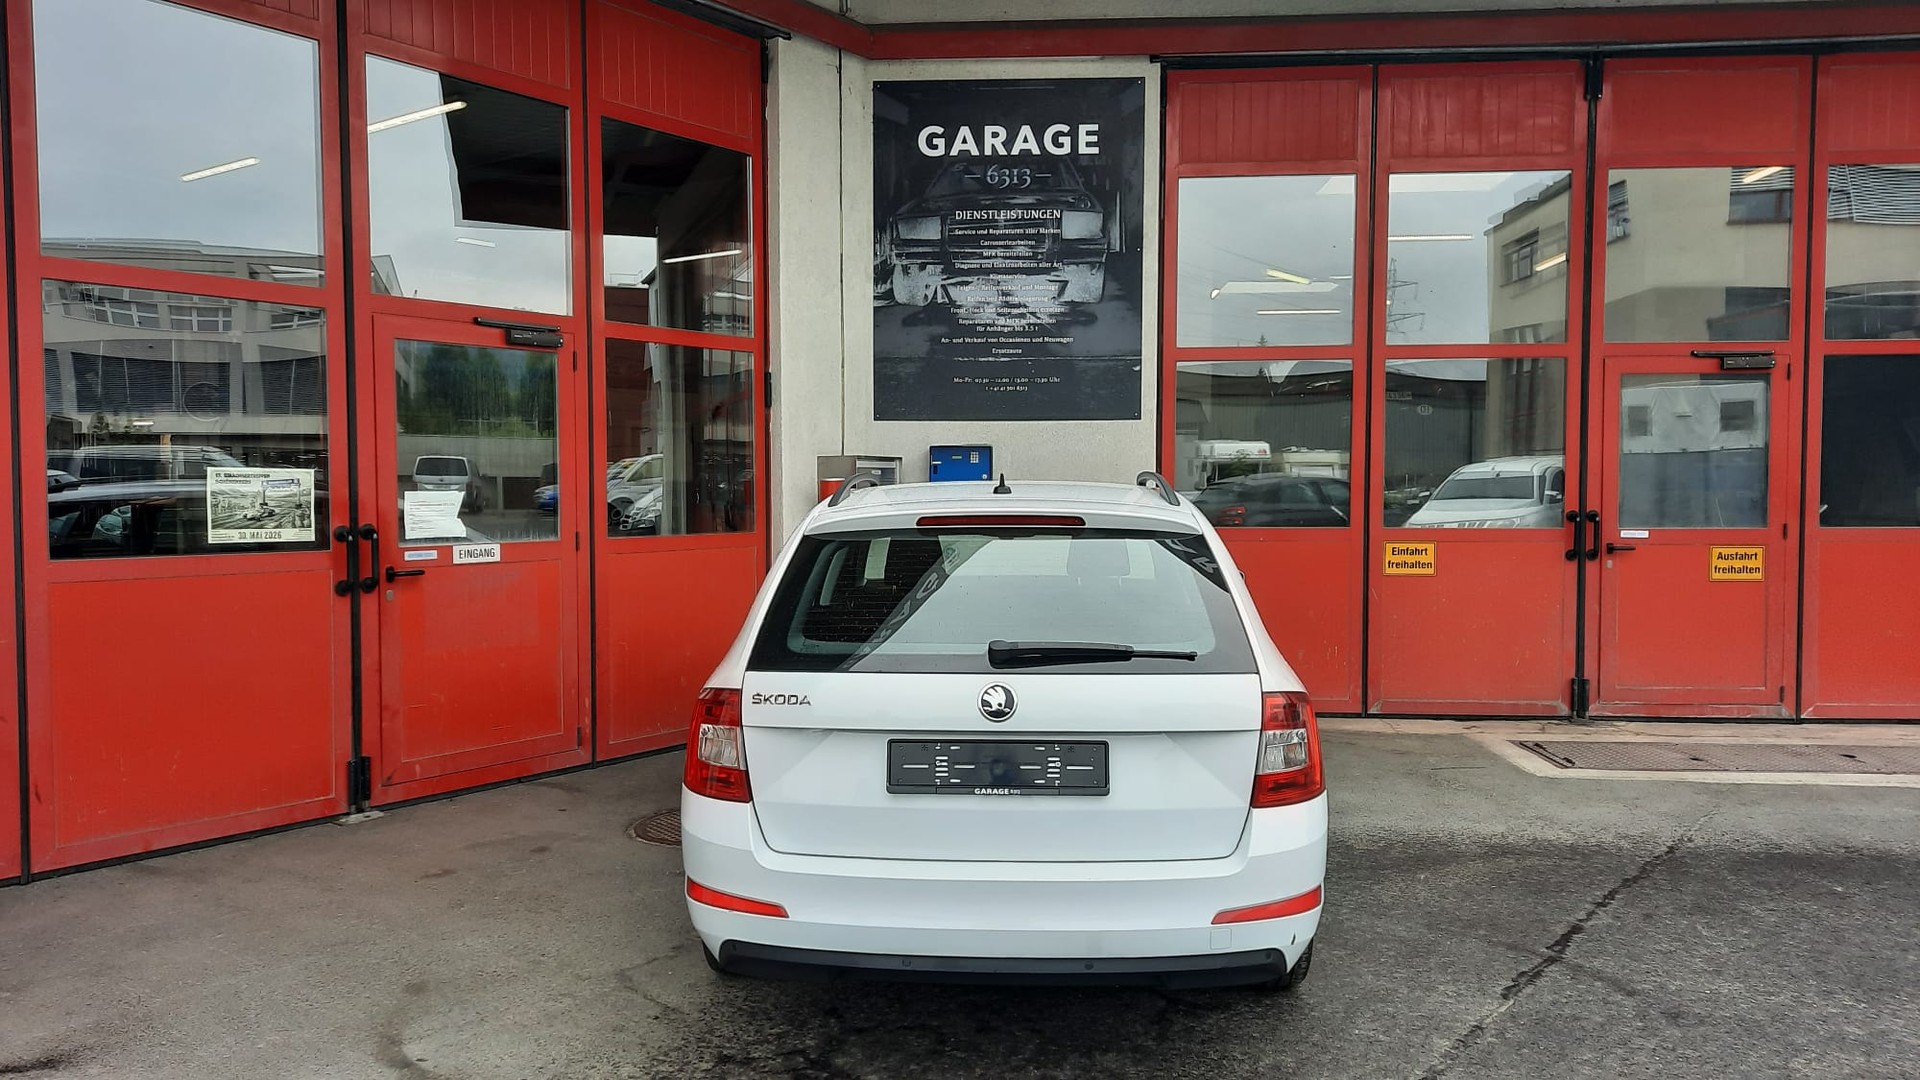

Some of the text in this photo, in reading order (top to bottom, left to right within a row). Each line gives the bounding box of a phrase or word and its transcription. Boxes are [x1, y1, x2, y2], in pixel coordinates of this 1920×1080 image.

[917, 123, 1100, 157] GARAGE
[986, 163, 1032, 189] 6313
[955, 209, 1061, 220] DIENSTLEISTUNGEN
[249, 531, 263, 539] MAI
[264, 531, 282, 539] 2026
[459, 548, 496, 559] EINGANG
[1391, 546, 1429, 557] Einfahrt
[1717, 551, 1758, 562] Ausfahrt
[1387, 559, 1433, 570] freihalten
[1714, 564, 1761, 575] freihalten
